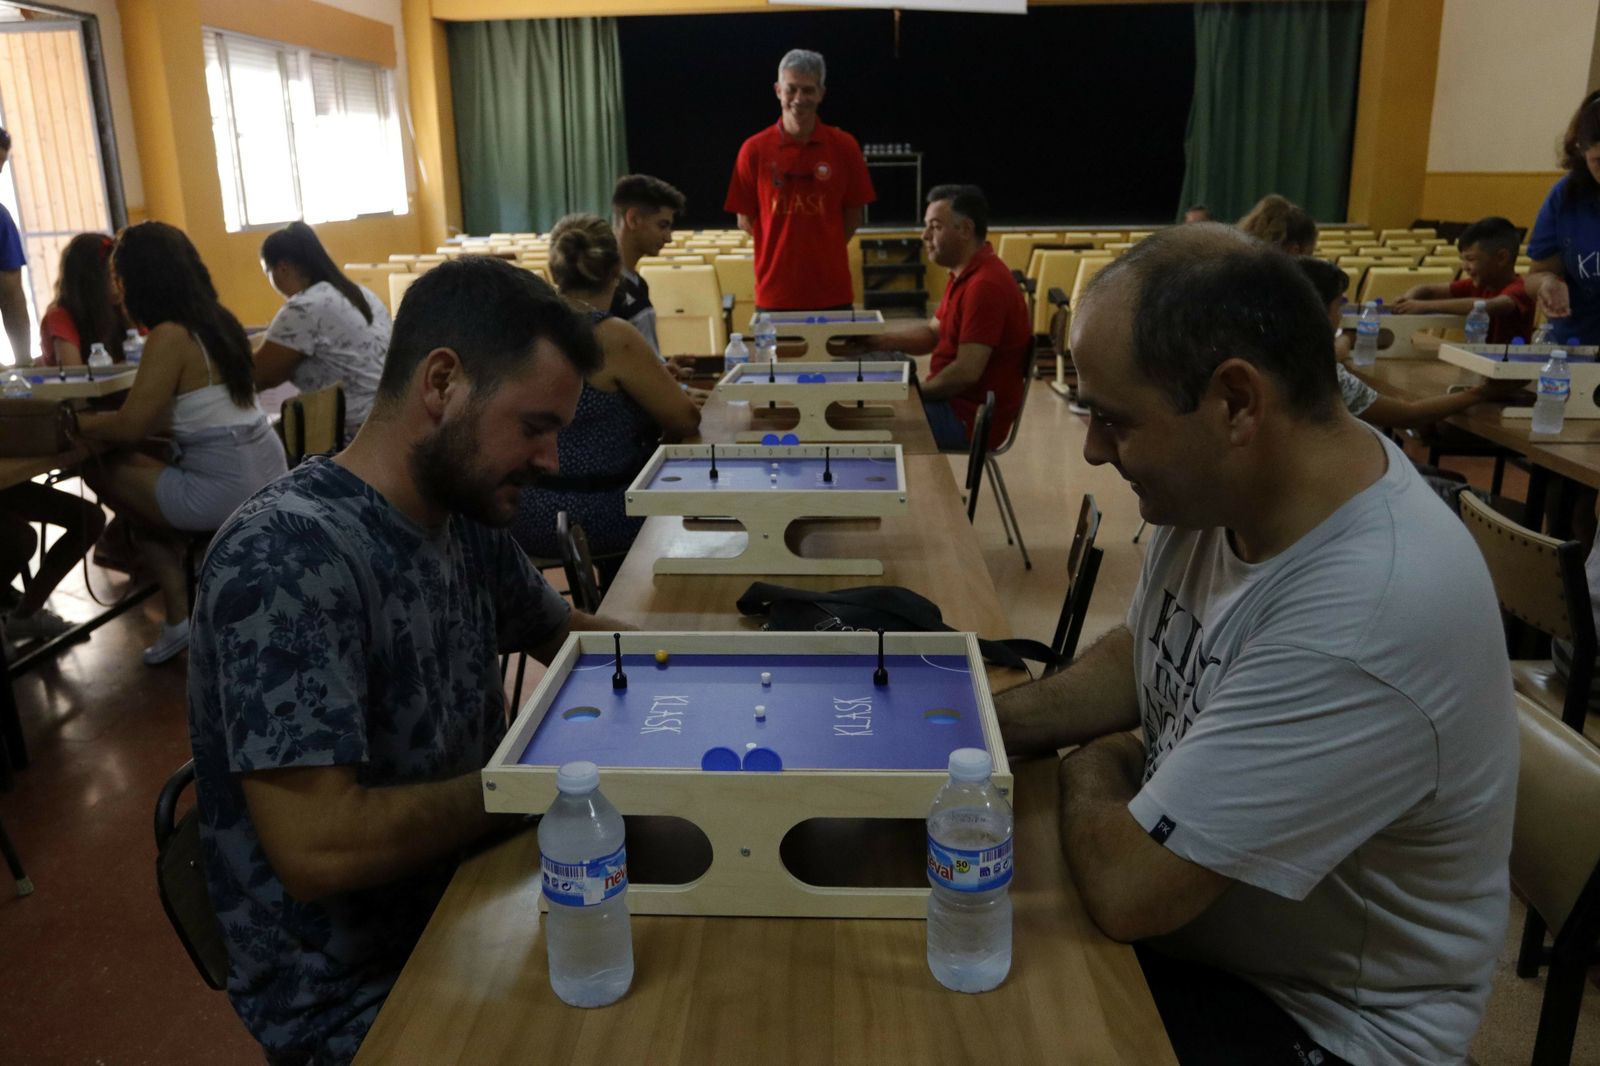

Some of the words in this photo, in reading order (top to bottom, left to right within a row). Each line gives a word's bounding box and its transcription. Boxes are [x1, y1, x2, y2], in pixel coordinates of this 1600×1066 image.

[640, 695, 689, 735] KLASK
[833, 696, 874, 736] KLASK
[605, 864, 627, 889] nev
[927, 857, 954, 880] eval
[956, 860, 968, 868] 50
